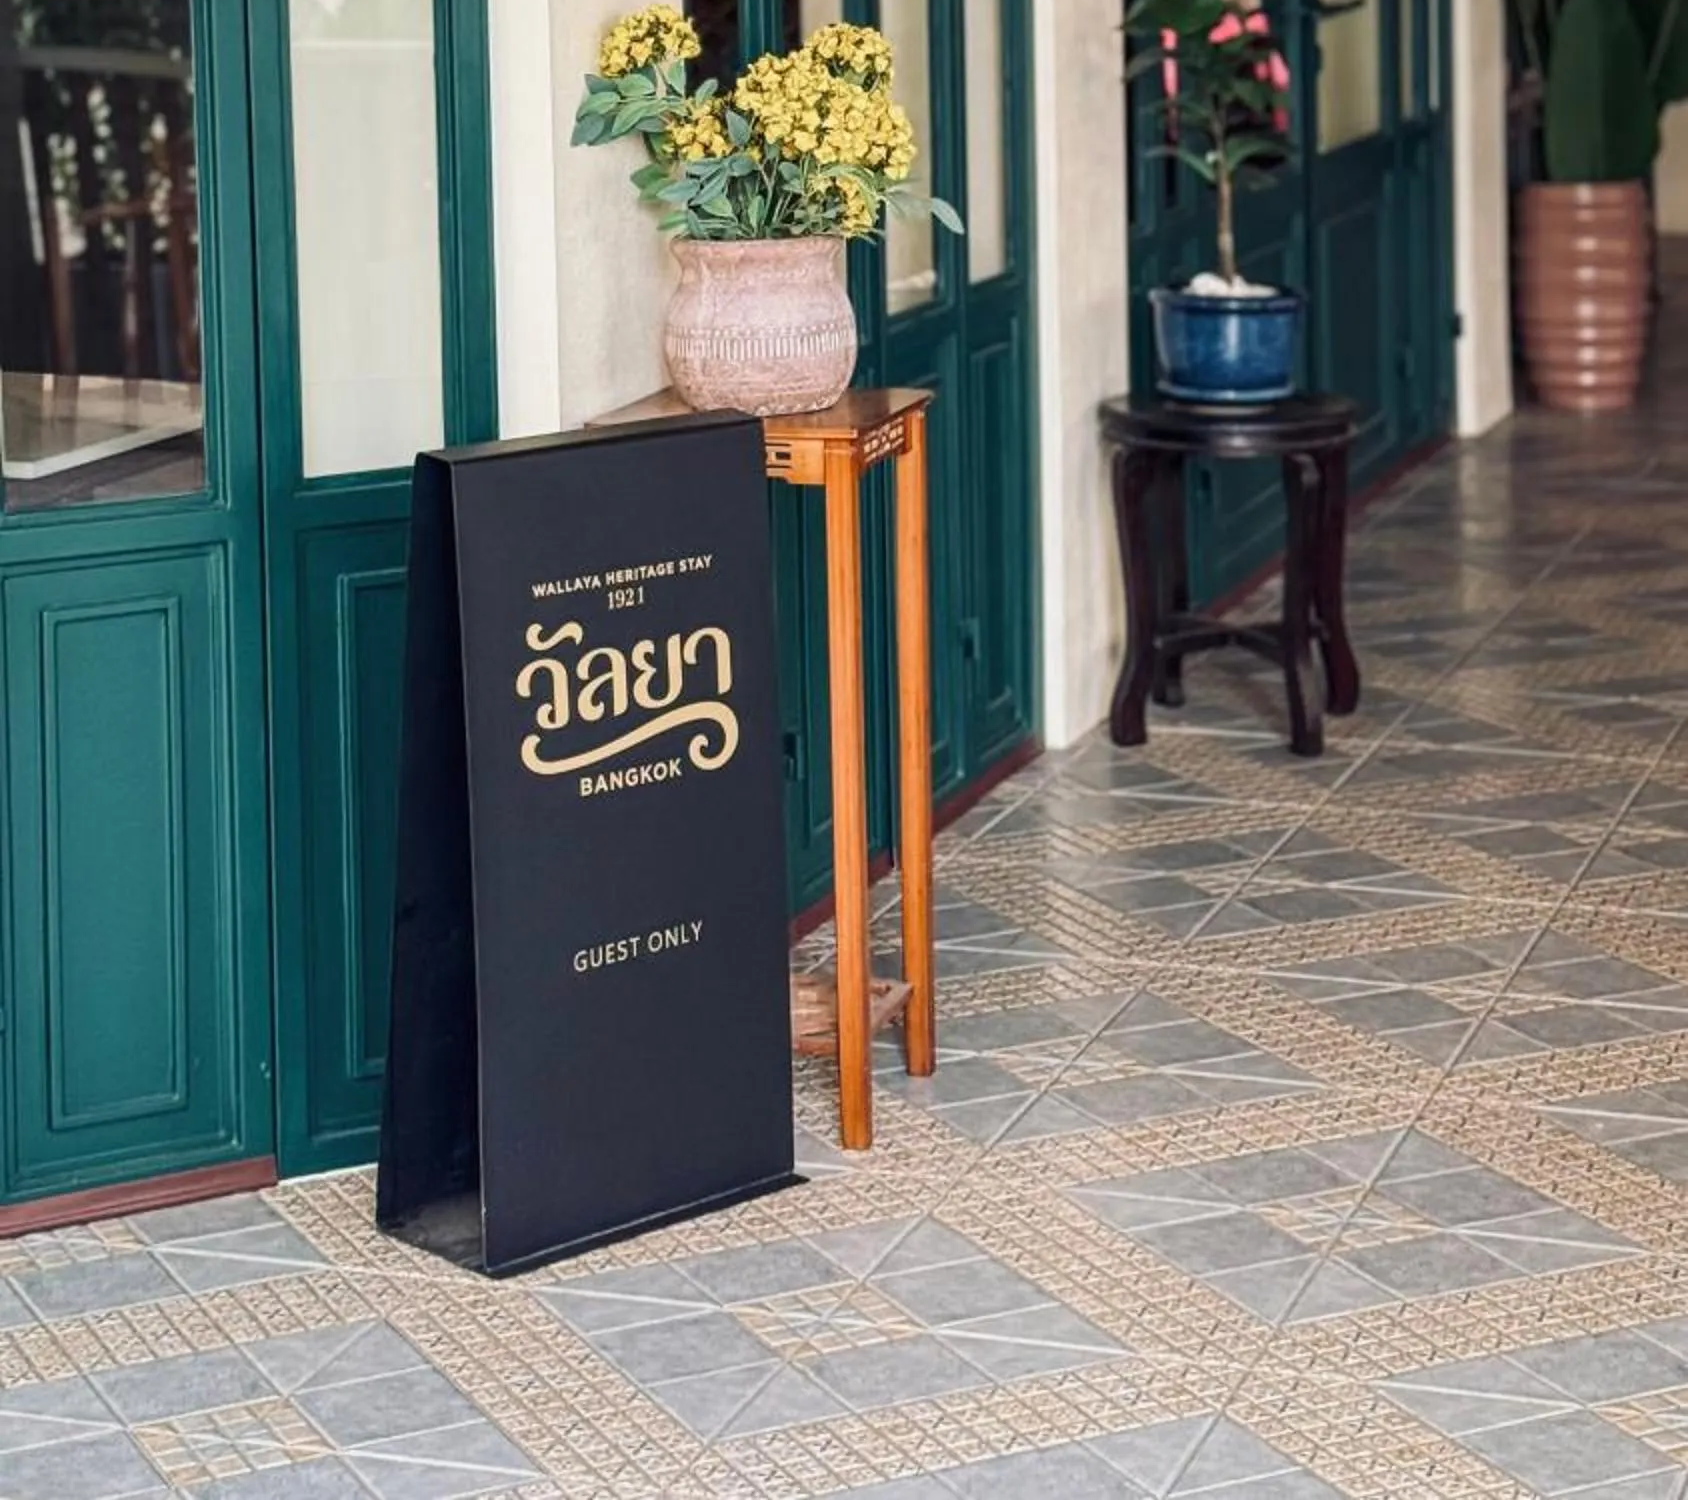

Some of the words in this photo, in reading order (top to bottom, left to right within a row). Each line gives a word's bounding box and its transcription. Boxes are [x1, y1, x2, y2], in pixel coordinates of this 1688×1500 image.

[532, 575, 601, 598] WALLAYA
[605, 561, 675, 586] HERITAGE
[678, 554, 713, 573] STAY
[608, 585, 645, 610] 1921
[515, 620, 733, 730] วัลยา
[579, 757, 682, 797] BANGKOK
[573, 936, 641, 973] GUEST
[647, 920, 704, 953] ONLY
